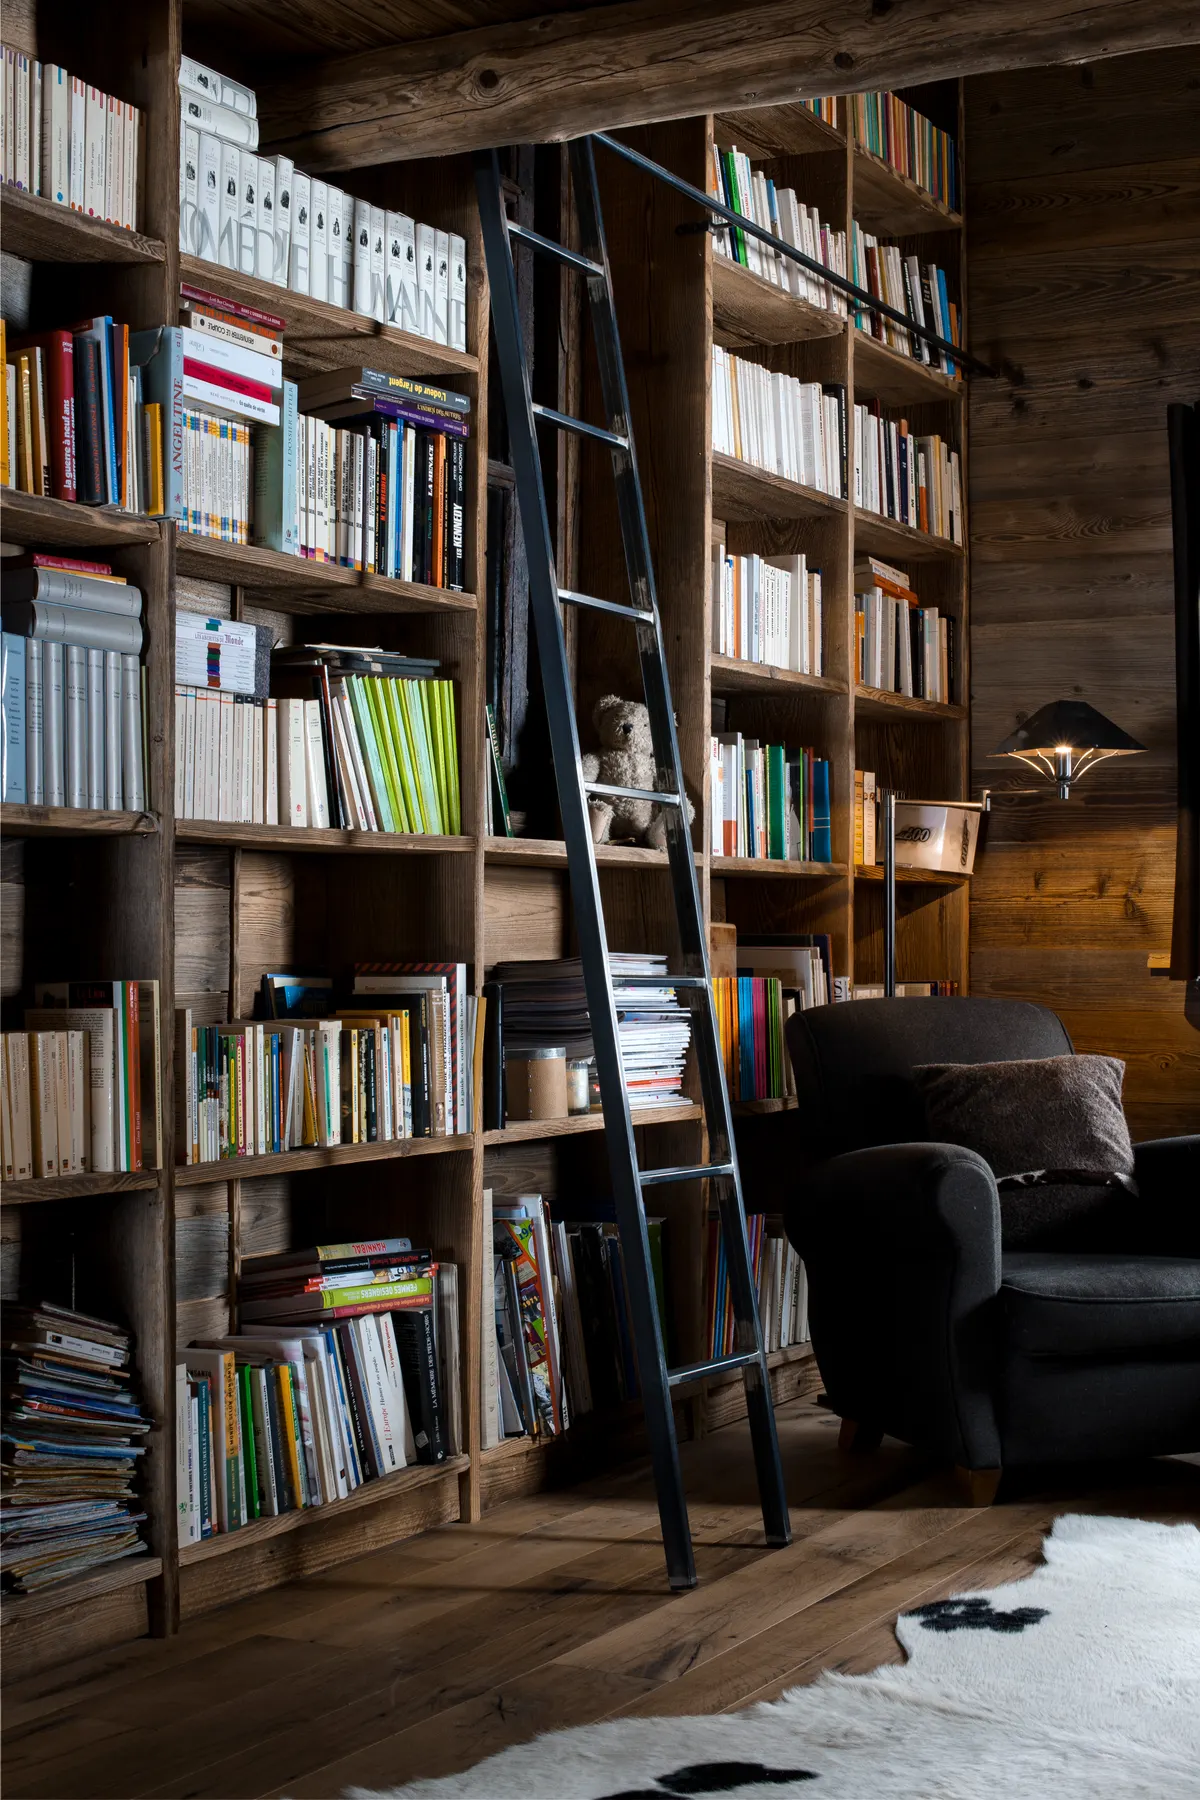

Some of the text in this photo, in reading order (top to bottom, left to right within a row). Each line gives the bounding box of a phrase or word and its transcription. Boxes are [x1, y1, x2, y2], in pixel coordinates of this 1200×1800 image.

[388, 377, 412, 392] l'argent
[414, 385, 422, 394] de
[424, 388, 446, 402] L'odeur
[62, 416, 71, 436] neuf
[64, 451, 73, 478] guerre
[64, 480, 72, 490] la
[428, 484, 434, 496] LA
[453, 504, 463, 547] KENNEDY
[352, 1242, 387, 1254] HANNIBAL
[360, 1286, 393, 1298] DESIGNERS
[394, 1283, 418, 1295] FEMMES
[423, 1315, 433, 1354] PIEDS-NOIRS
[432, 1400, 438, 1409] LA
[380, 1408, 393, 1442] L'Europe
